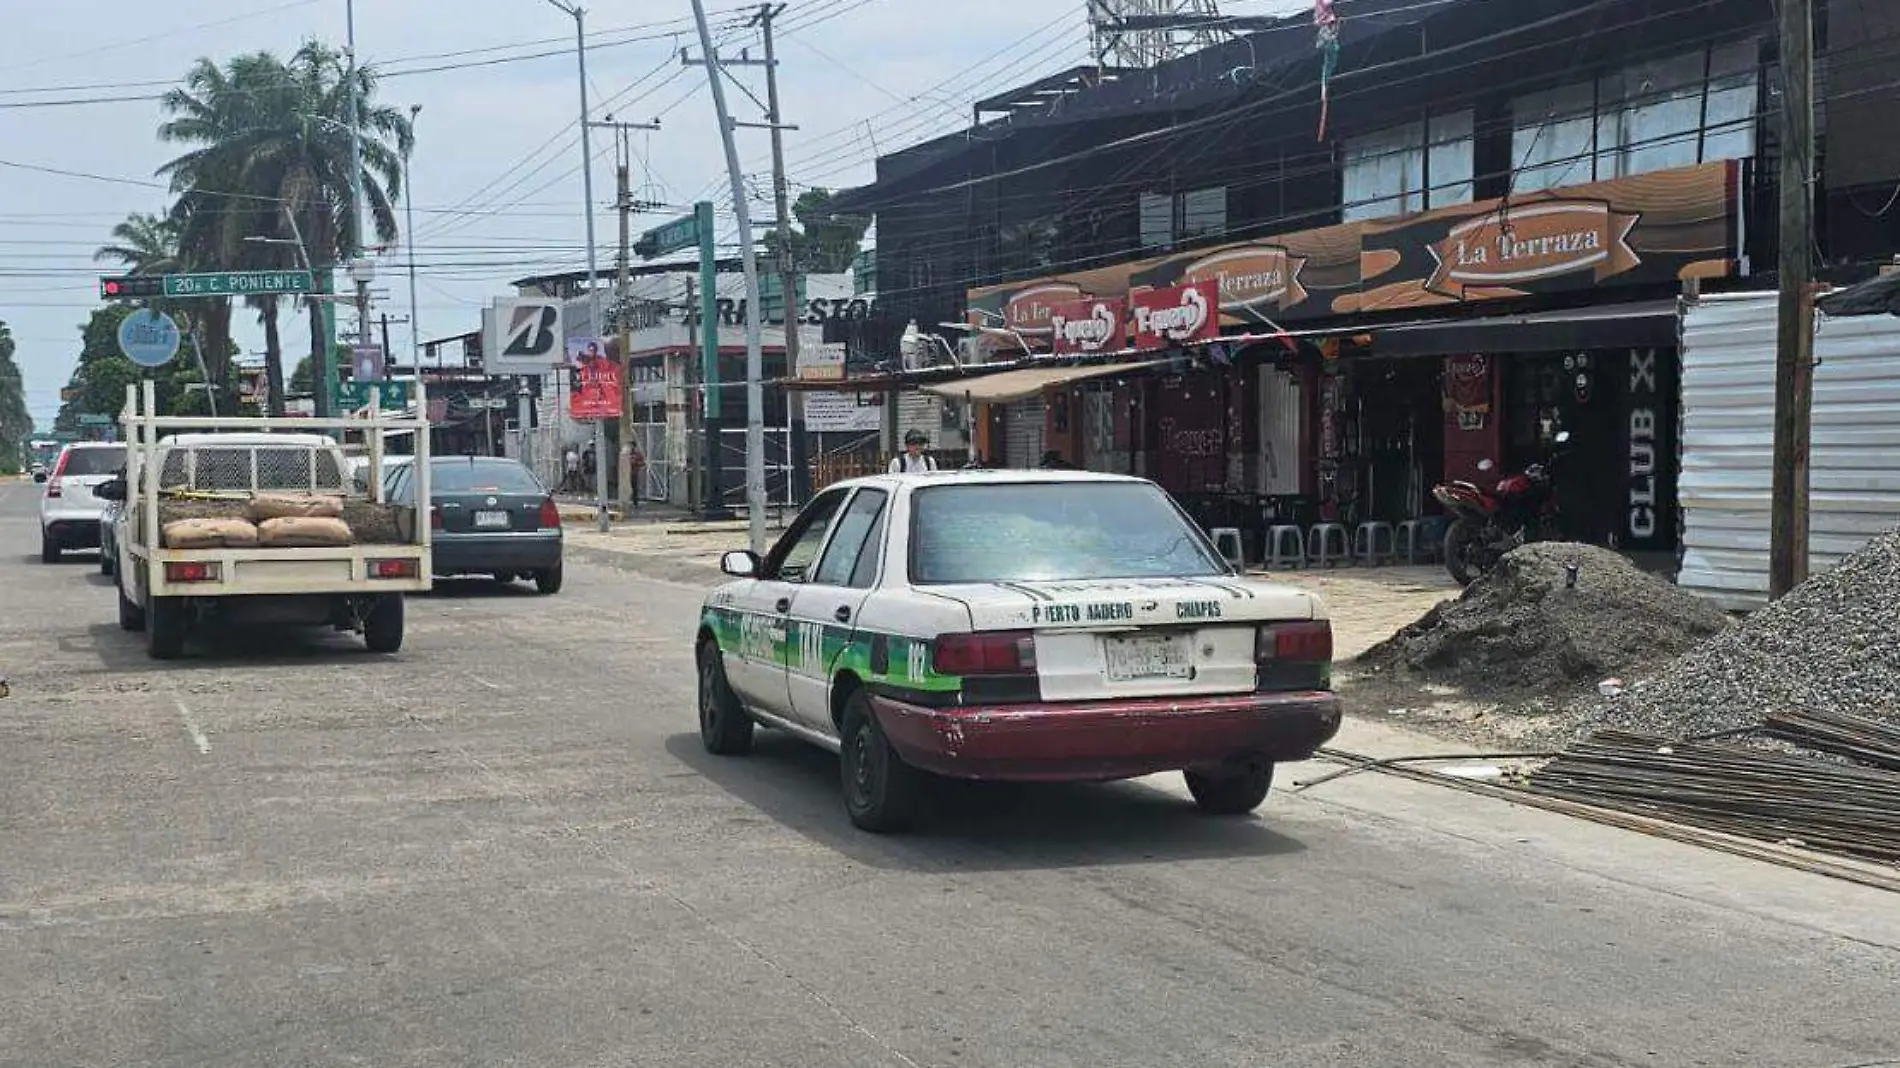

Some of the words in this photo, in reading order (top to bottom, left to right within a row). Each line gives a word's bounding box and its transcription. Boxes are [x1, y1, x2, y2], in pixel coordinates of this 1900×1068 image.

[1458, 240, 1487, 265] La
[1496, 230, 1599, 260] Terraza
[229, 275, 301, 289] PONIENTE
[1631, 350, 1655, 392] X
[1631, 408, 1655, 538] CLUB
